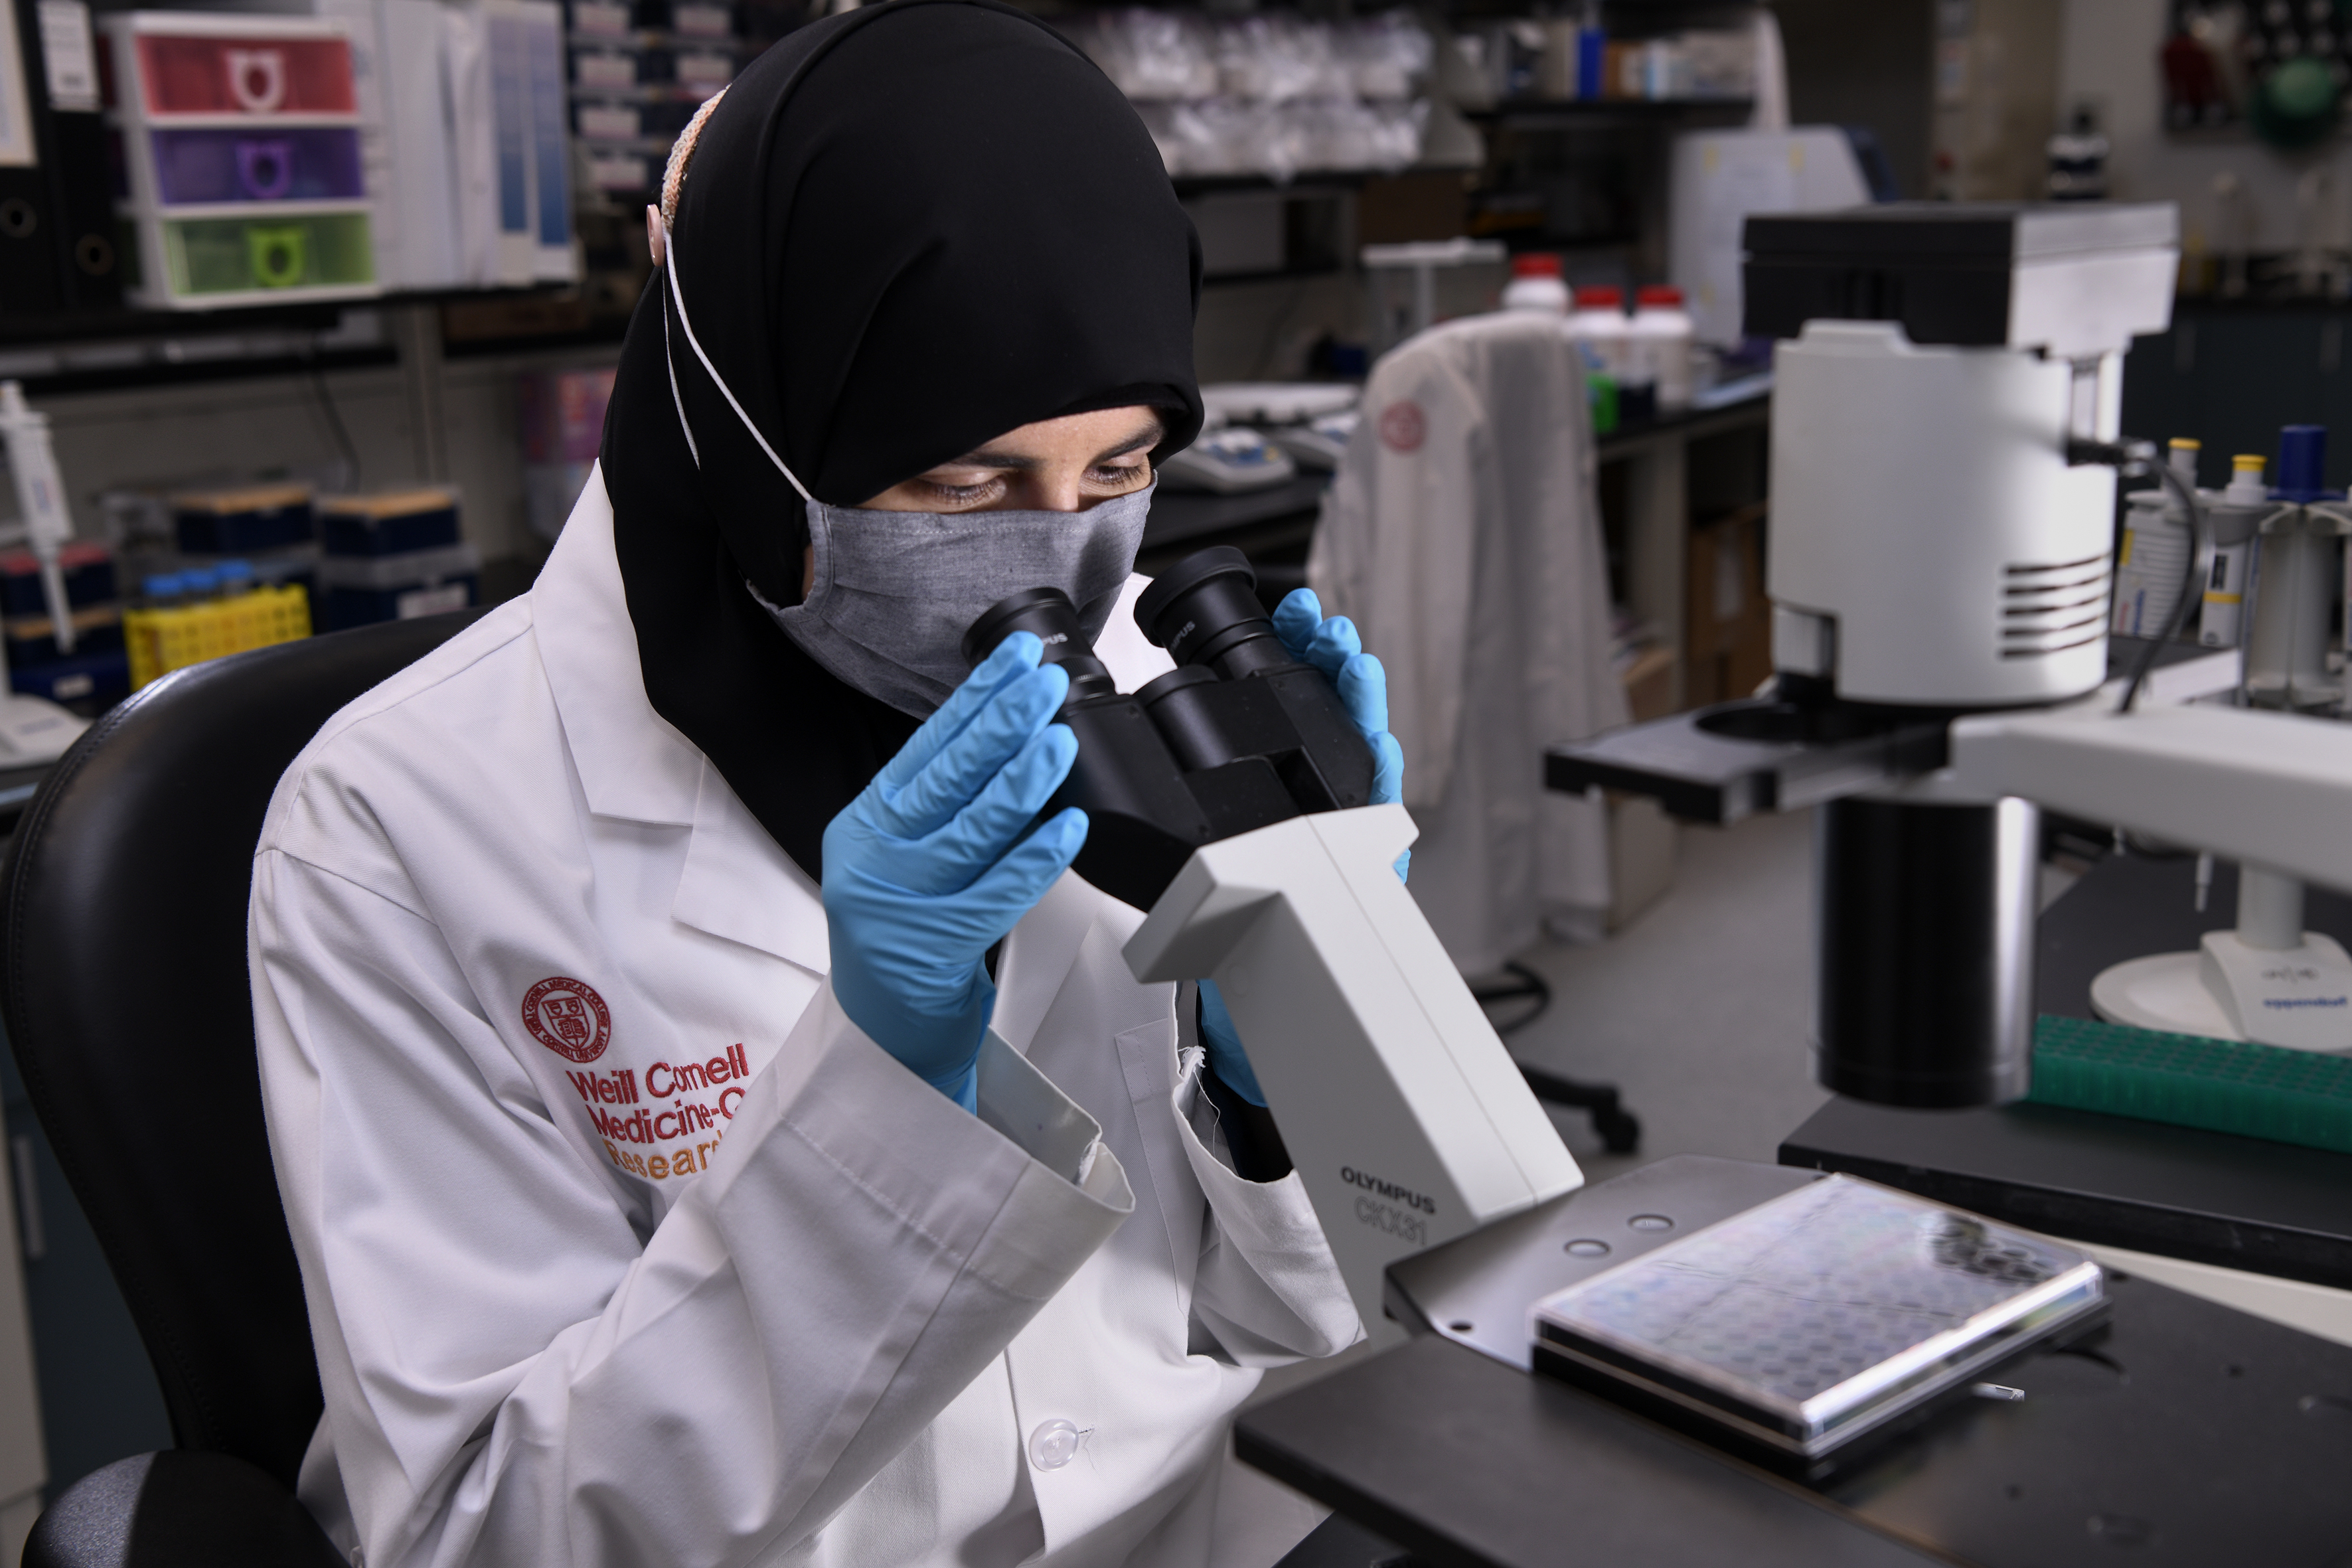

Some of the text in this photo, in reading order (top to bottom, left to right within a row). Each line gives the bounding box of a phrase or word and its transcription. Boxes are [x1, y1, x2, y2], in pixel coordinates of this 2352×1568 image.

[566, 1043, 749, 1104] Weill Cornell
[603, 1129, 722, 1179] Resear
[1340, 1166, 1436, 1214] OLYMPUS
[1354, 1196, 1426, 1245] CKX31
